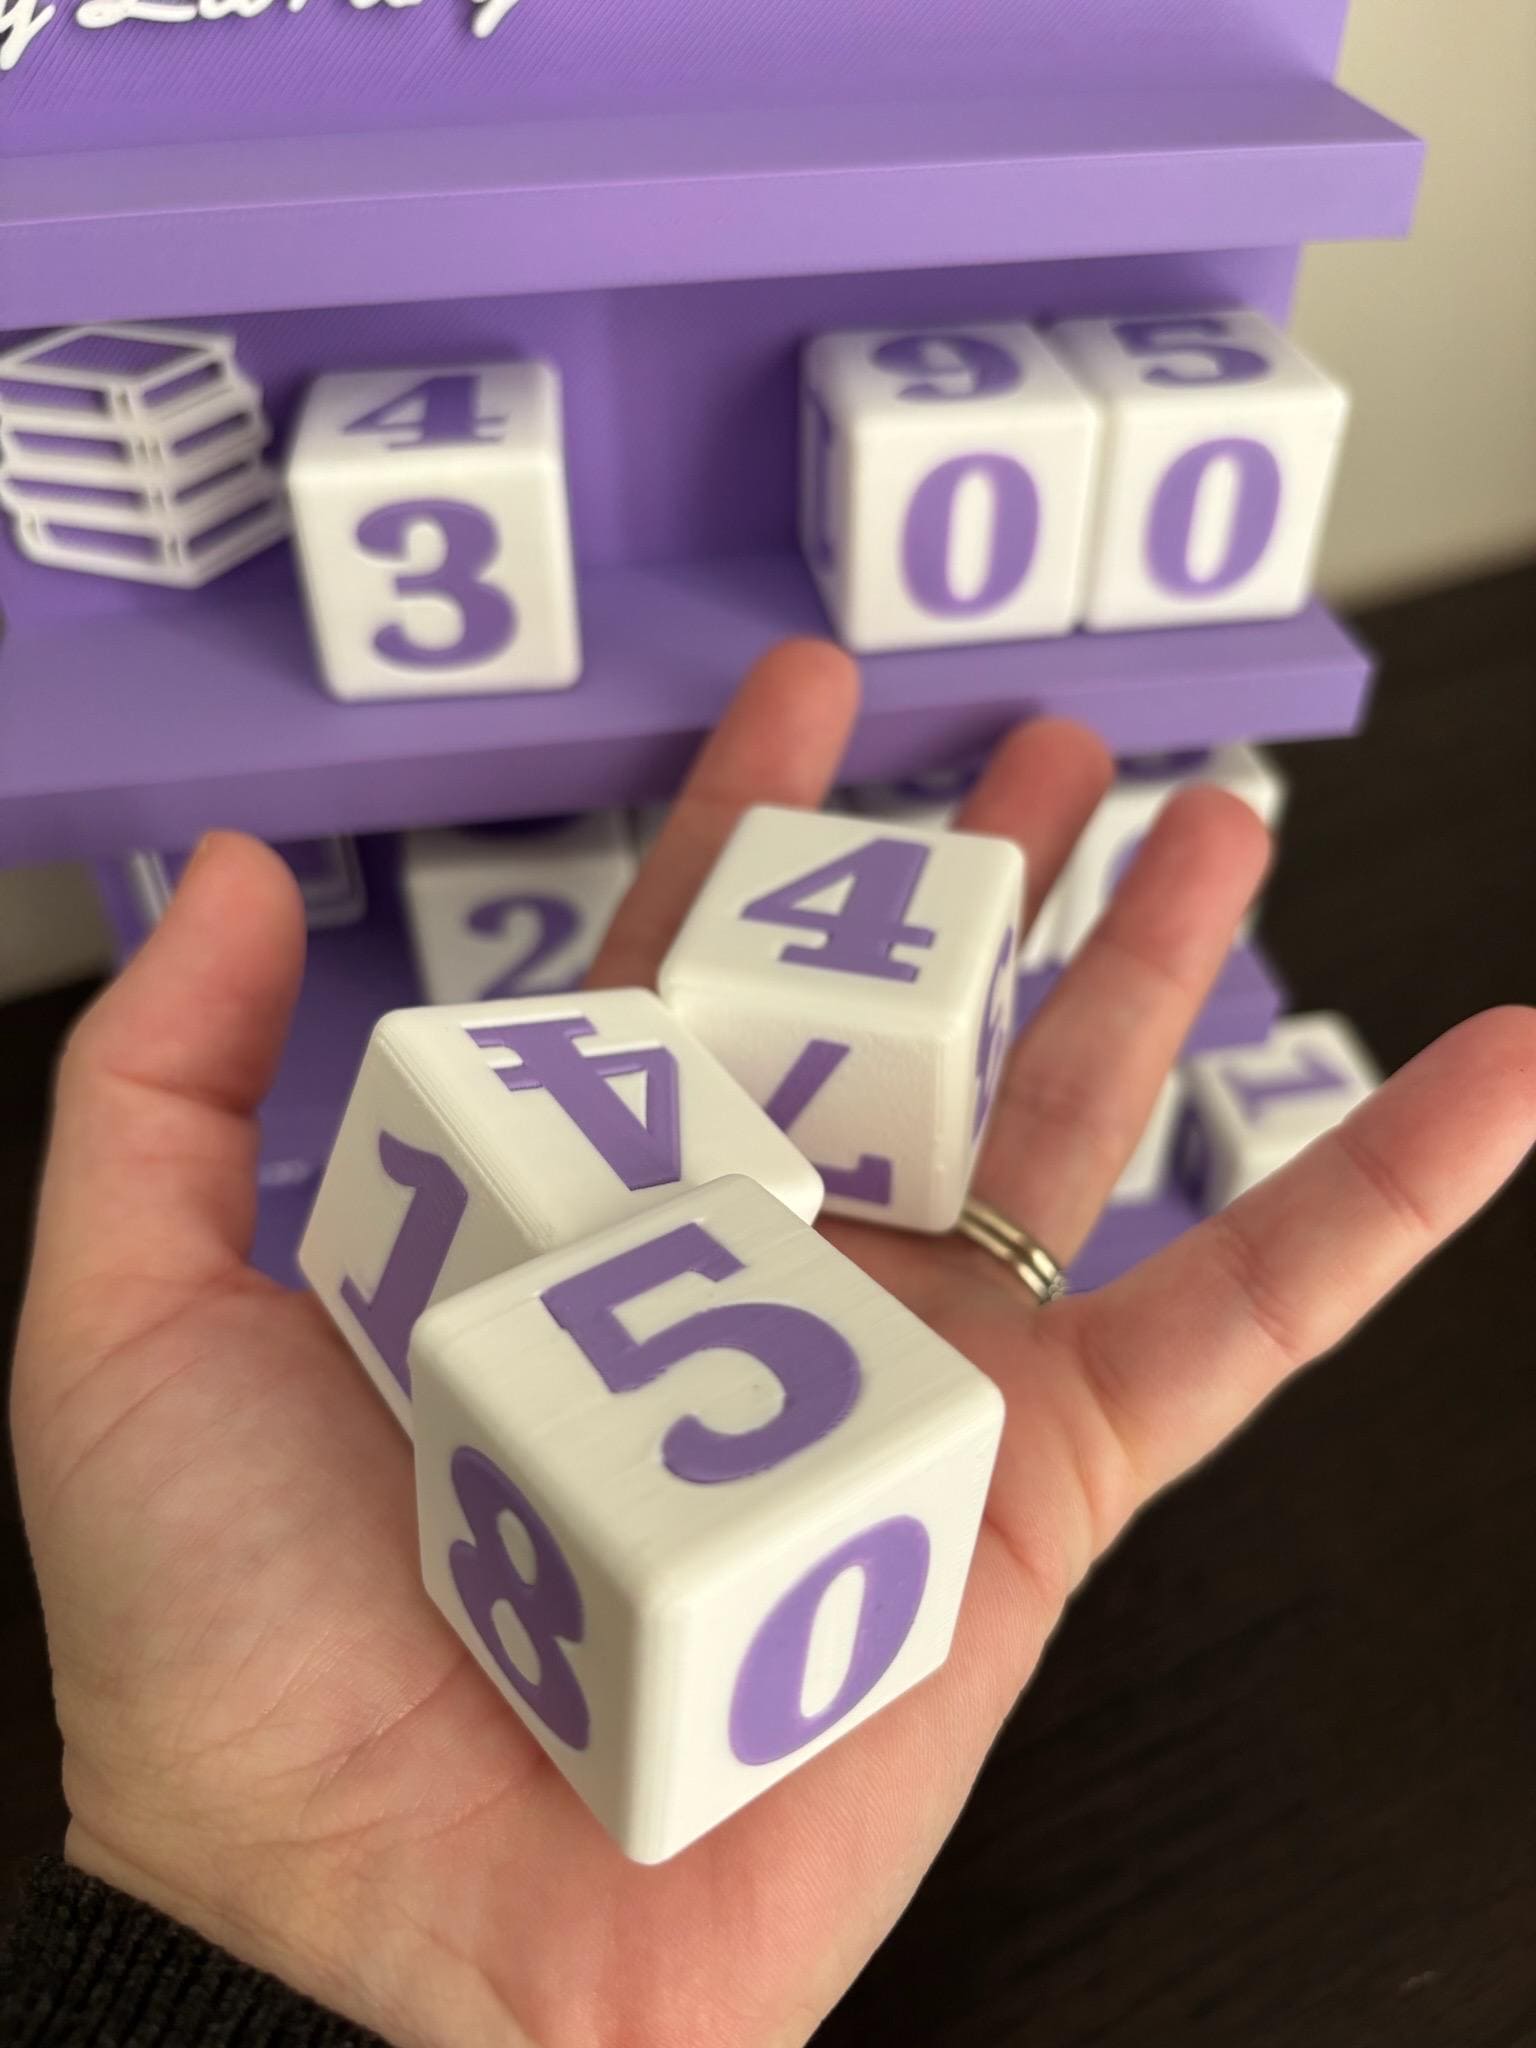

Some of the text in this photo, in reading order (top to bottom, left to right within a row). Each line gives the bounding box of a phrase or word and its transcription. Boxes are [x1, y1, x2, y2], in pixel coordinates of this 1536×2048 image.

[342, 373, 510, 449] 4
[867, 333, 1025, 401] 9
[1111, 317, 1272, 386] 5
[354, 498, 518, 672] 3
[901, 452, 1041, 622] 0
[1147, 437, 1283, 603] 0
[465, 890, 587, 1000] 2
[738, 837, 937, 983] 4
[463, 1016, 683, 1191] 4
[540, 1220, 863, 1486] 5
[448, 1445, 592, 1753] 8
[728, 1514, 932, 1767] 0
